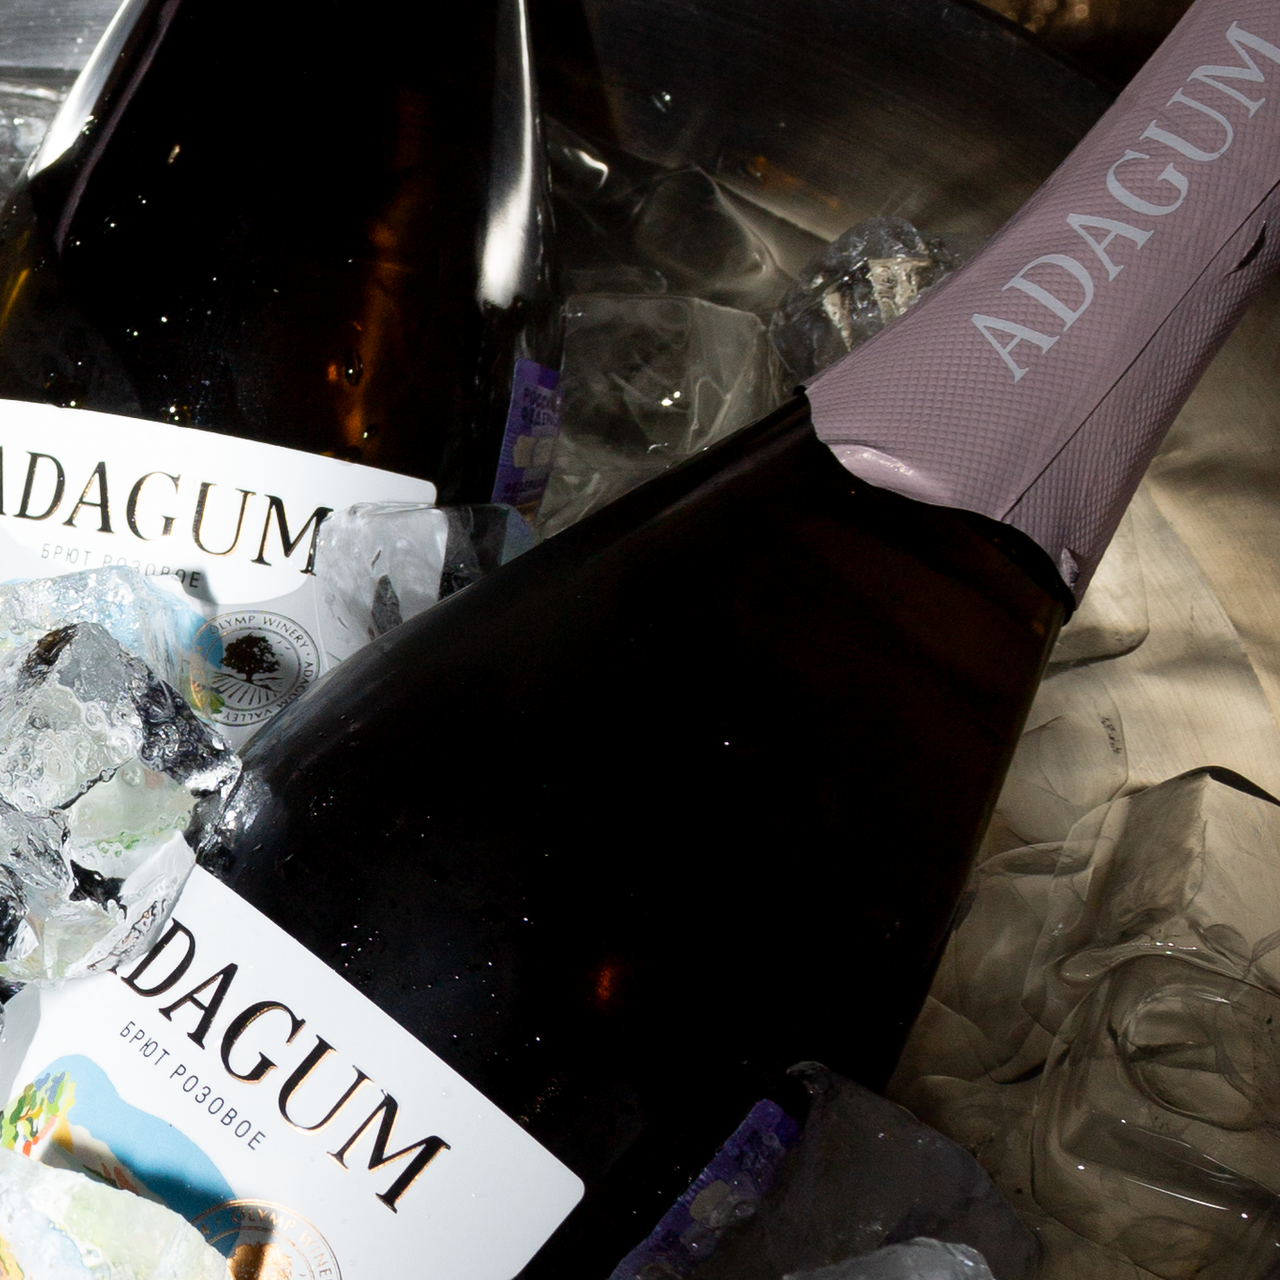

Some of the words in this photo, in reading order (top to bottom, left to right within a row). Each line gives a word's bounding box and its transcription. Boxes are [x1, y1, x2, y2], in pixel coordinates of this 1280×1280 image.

[971, 21, 1280, 382] ADAGUM
[41, 543, 92, 566] БРЮТ
[209, 615, 256, 635] OLYMP
[263, 616, 310, 649] WINERY
[222, 709, 273, 722] VALLEY
[106, 917, 451, 1214] DAGUM
[120, 1021, 171, 1065] БРЮТ
[169, 1064, 266, 1151] РОЗОВОЕ
[231, 1207, 296, 1231] OLYMP
